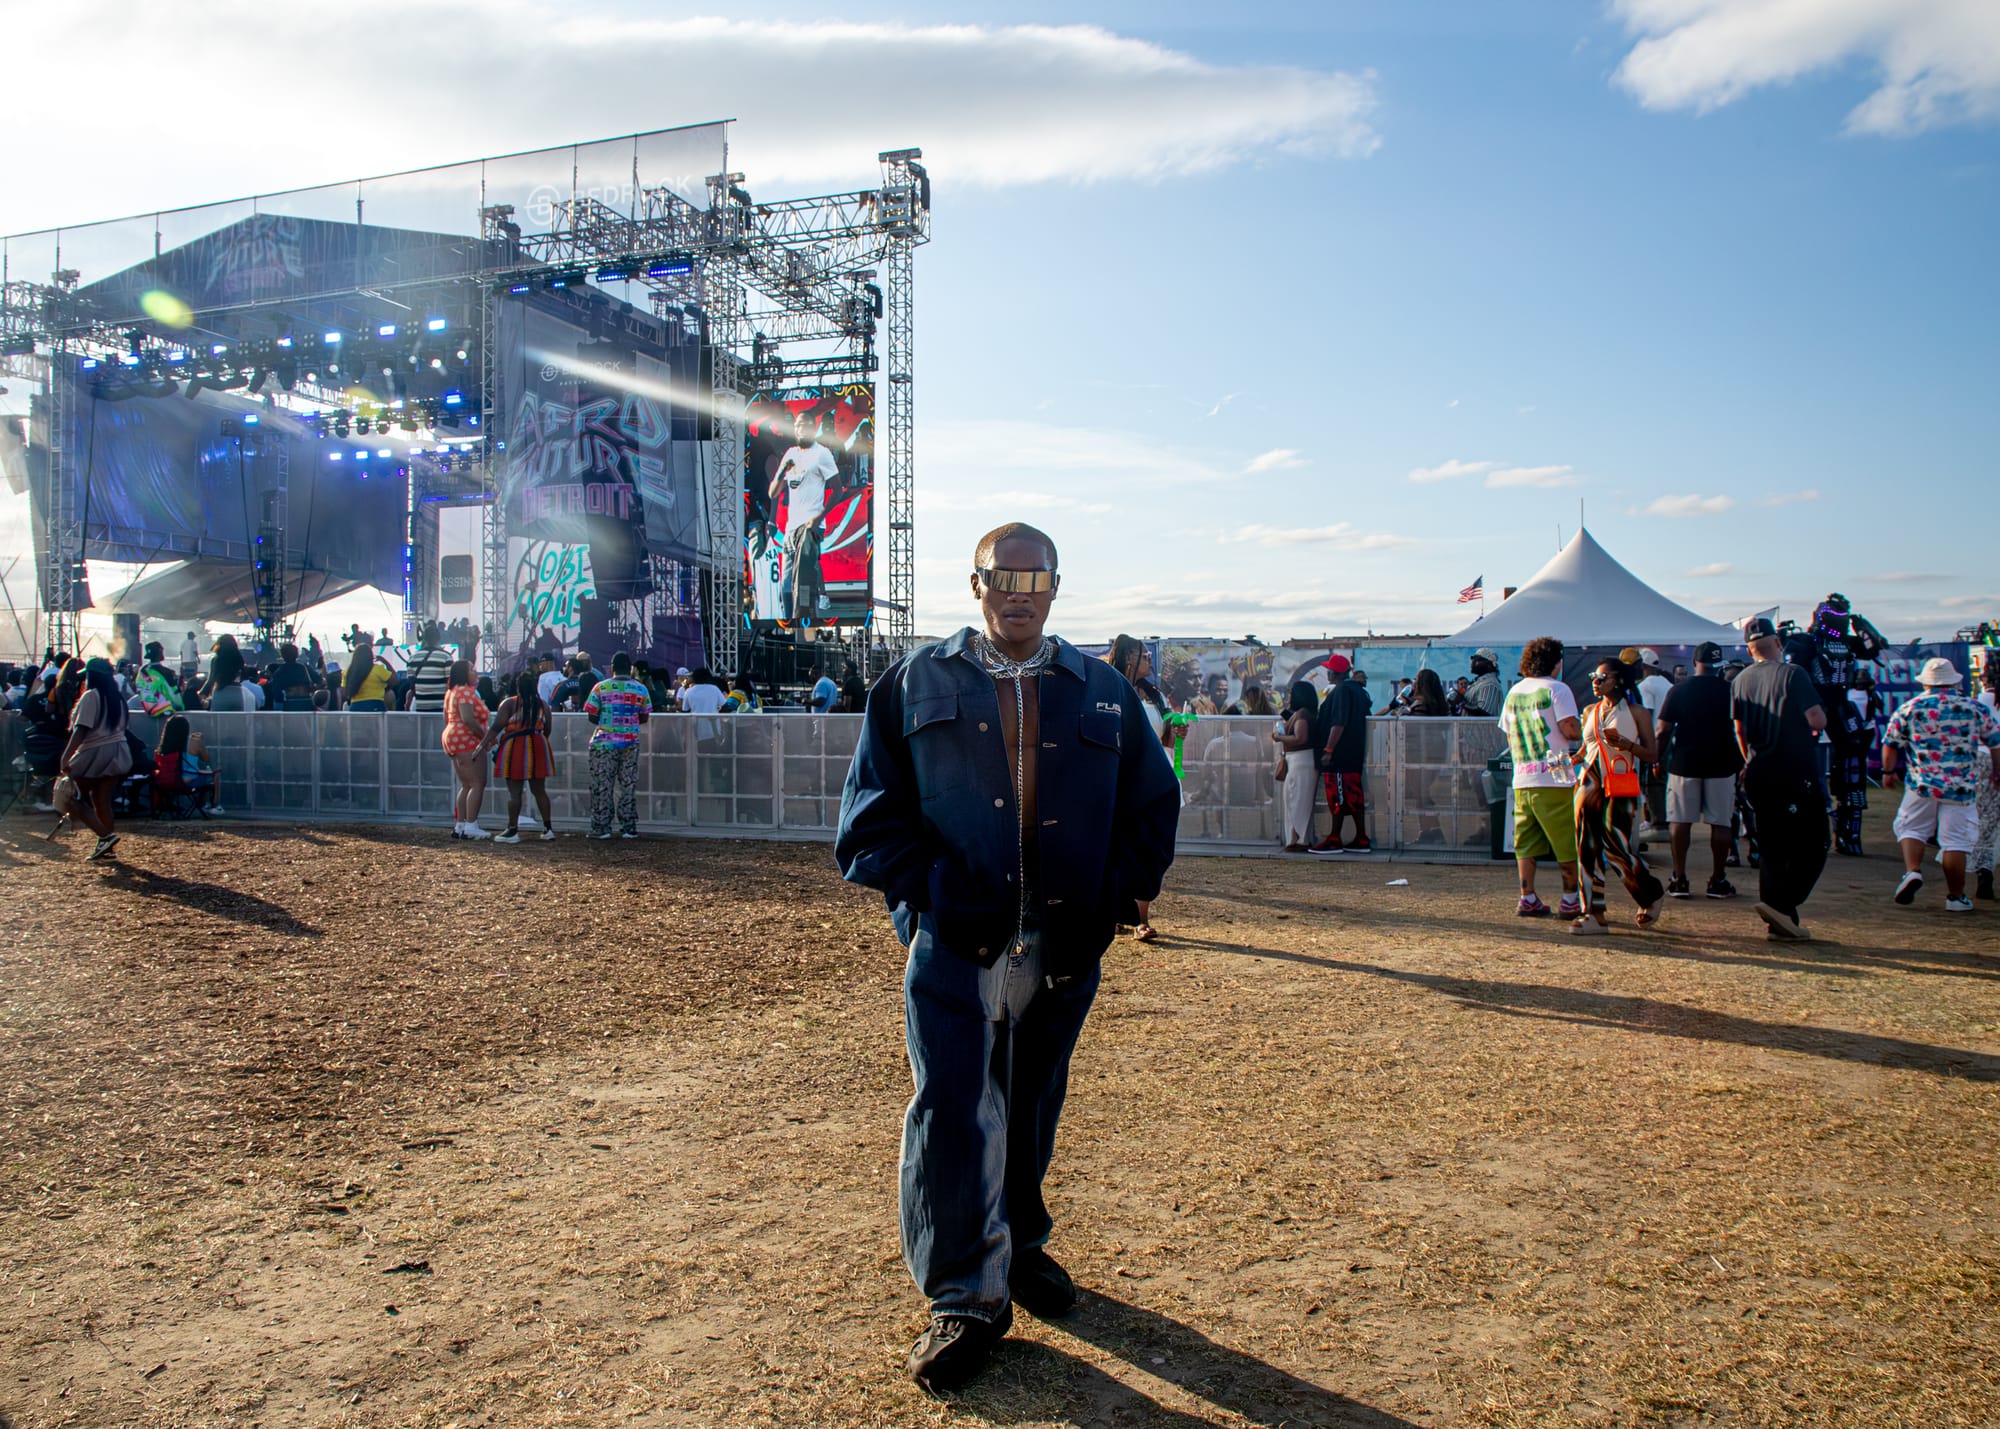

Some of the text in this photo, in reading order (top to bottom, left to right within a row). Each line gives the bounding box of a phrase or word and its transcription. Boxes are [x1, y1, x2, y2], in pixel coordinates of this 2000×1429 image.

[507, 387, 669, 456] AFRO
[502, 432, 676, 510] FUTURE
[521, 482, 634, 527] DETROIT
